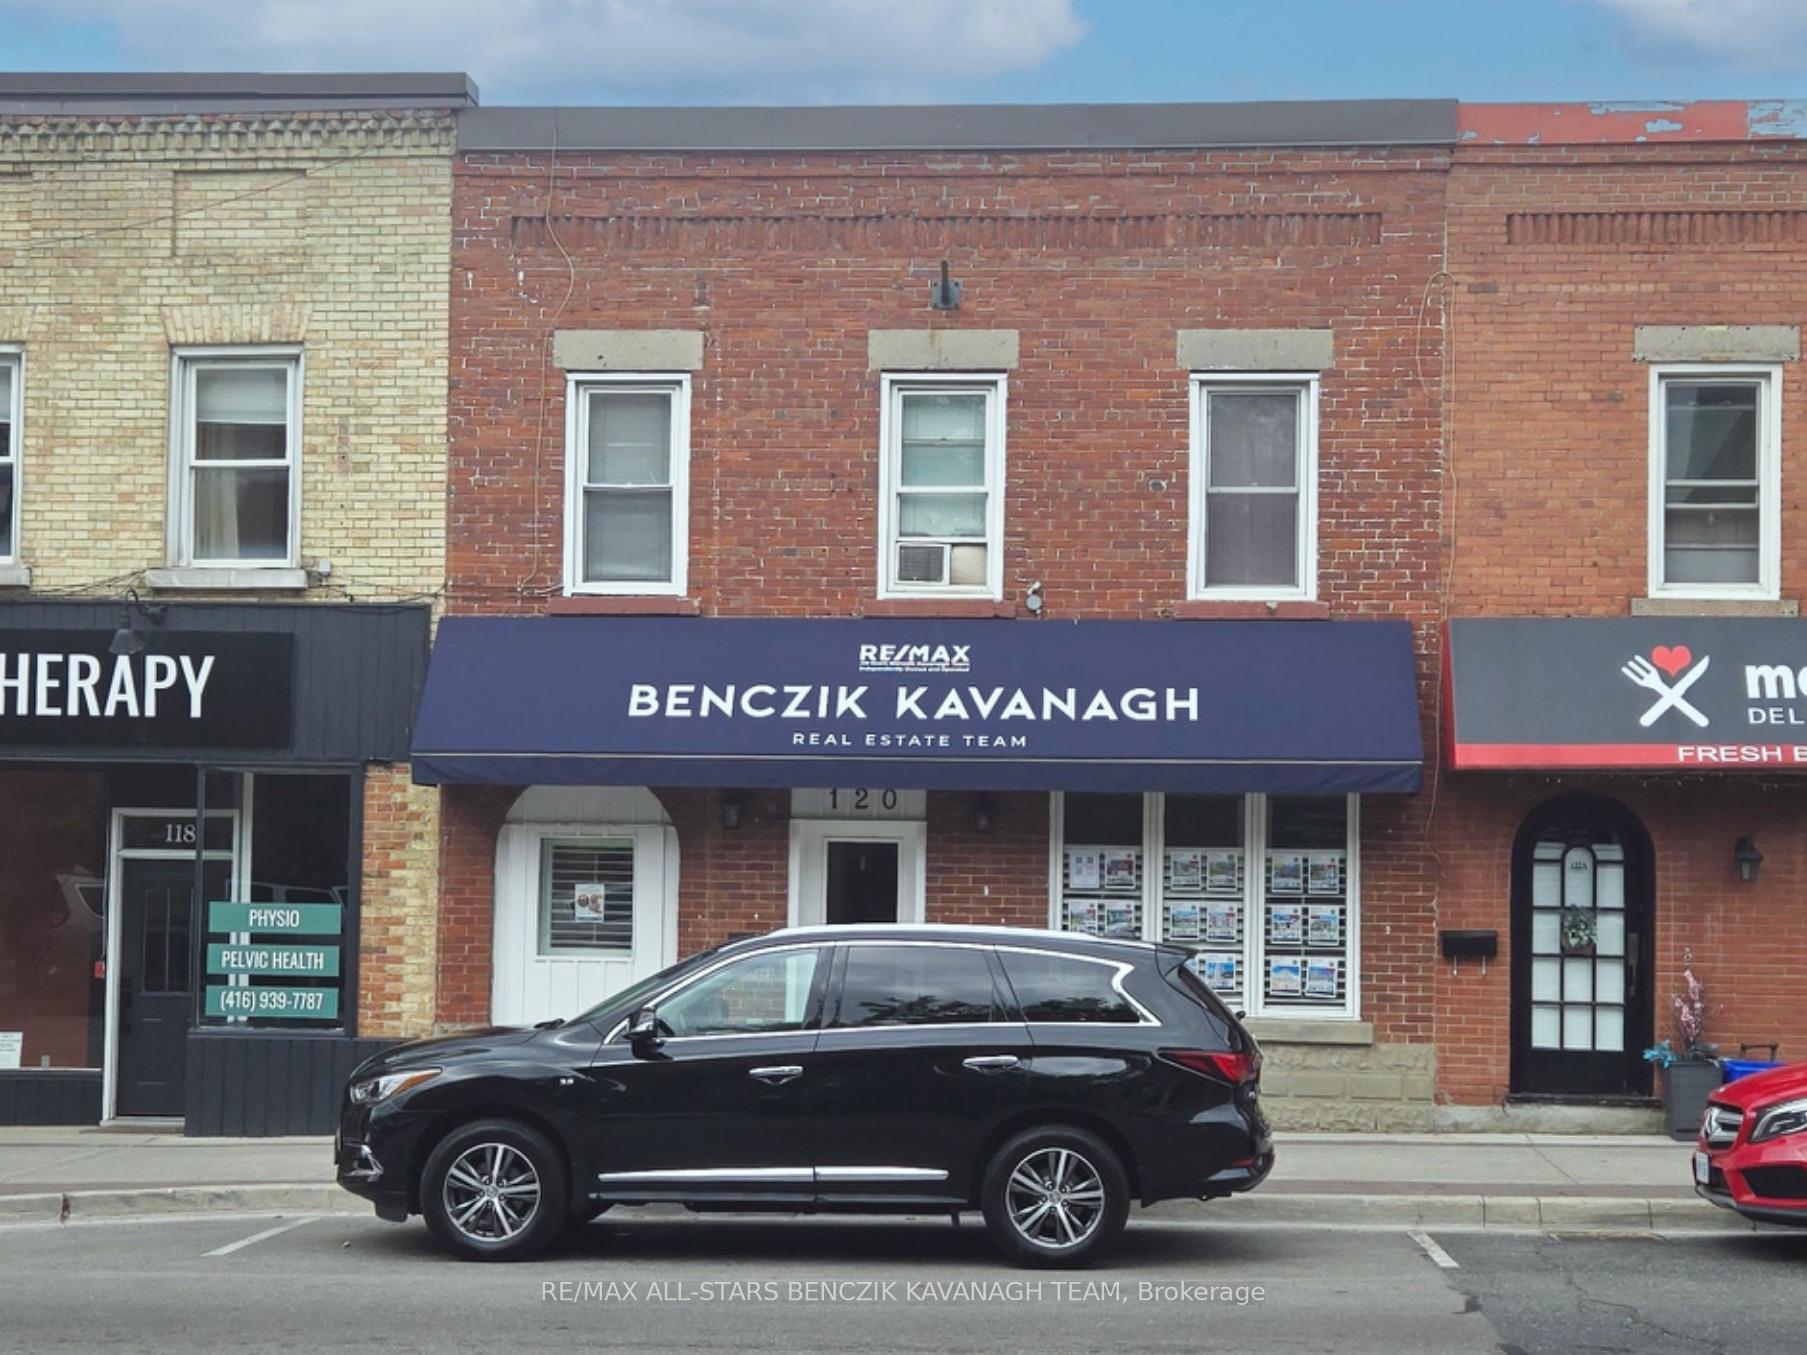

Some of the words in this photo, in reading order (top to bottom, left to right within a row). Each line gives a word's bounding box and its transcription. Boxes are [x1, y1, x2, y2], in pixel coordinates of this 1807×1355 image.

[859, 644, 970, 662] RE/MAX
[628, 685, 868, 718] BENCZIK
[896, 686, 1199, 721] KAVANAGH
[792, 733, 852, 746] REAL
[865, 734, 950, 747] ESTATE
[962, 735, 1027, 748] TEAM
[1678, 745, 1782, 762] FRESH
[829, 787, 897, 810] 120
[165, 823, 196, 843] 118
[249, 909, 300, 928] PHYSIO
[221, 951, 268, 969] PELVIC
[272, 953, 324, 970] HEALTH
[220, 991, 256, 1012] (416)
[259, 992, 323, 1010] 939-7787
